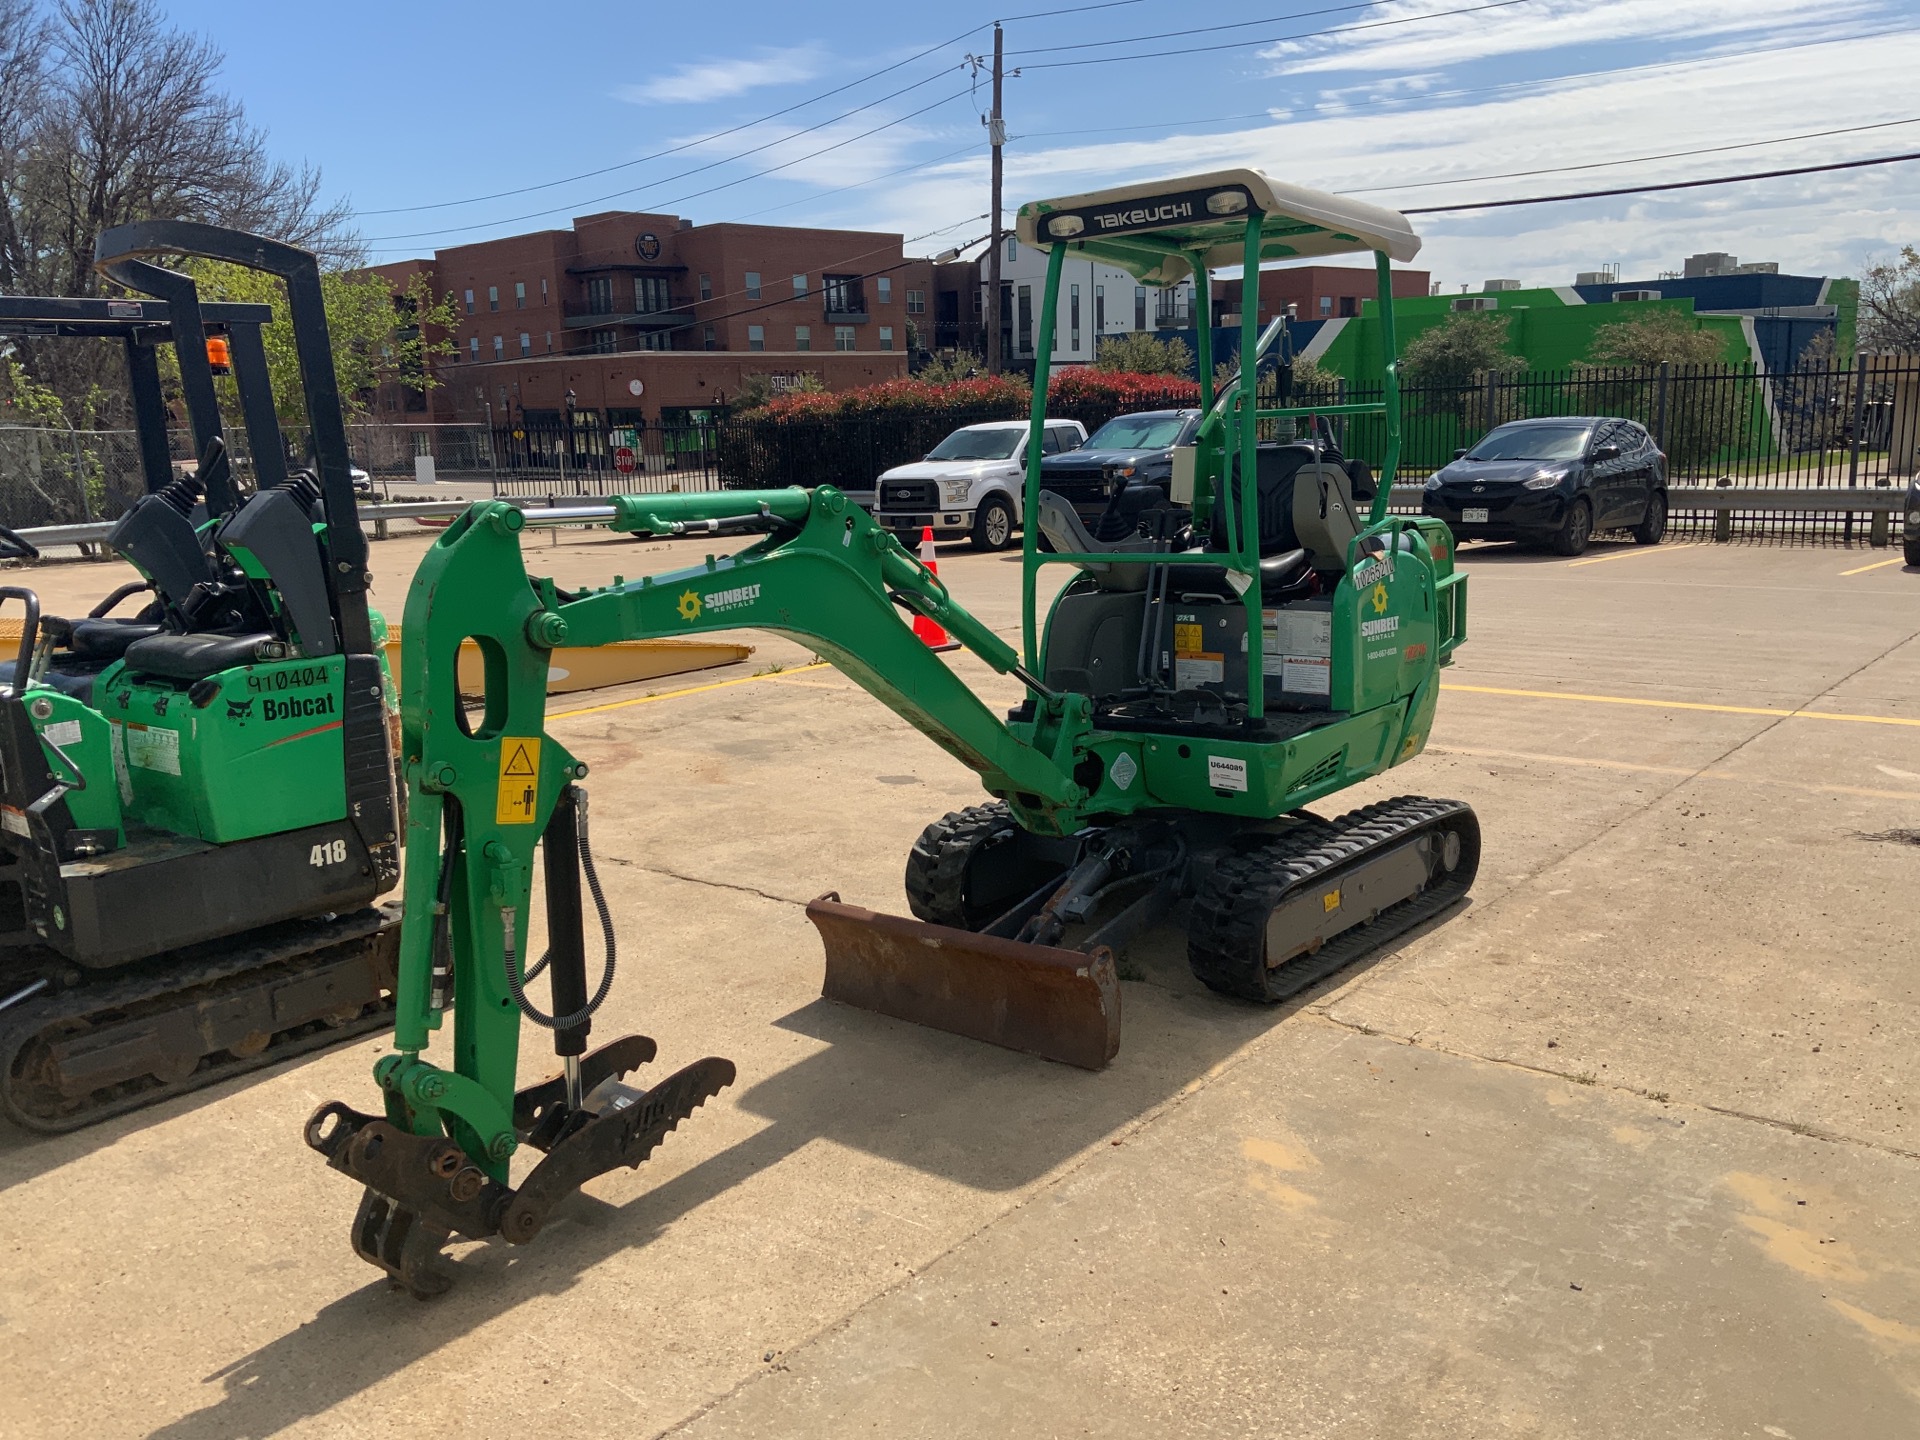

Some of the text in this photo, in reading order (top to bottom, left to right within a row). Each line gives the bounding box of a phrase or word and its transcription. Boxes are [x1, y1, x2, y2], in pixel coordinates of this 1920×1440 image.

[704, 584, 760, 609] SUNBELT
[714, 600, 754, 613] RENTALS
[1361, 616, 1399, 637] SUNBELT
[1367, 632, 1395, 642] RENTALS
[248, 666, 328, 693] 910404
[263, 693, 335, 721] Bobcat
[310, 840, 347, 867] 418
